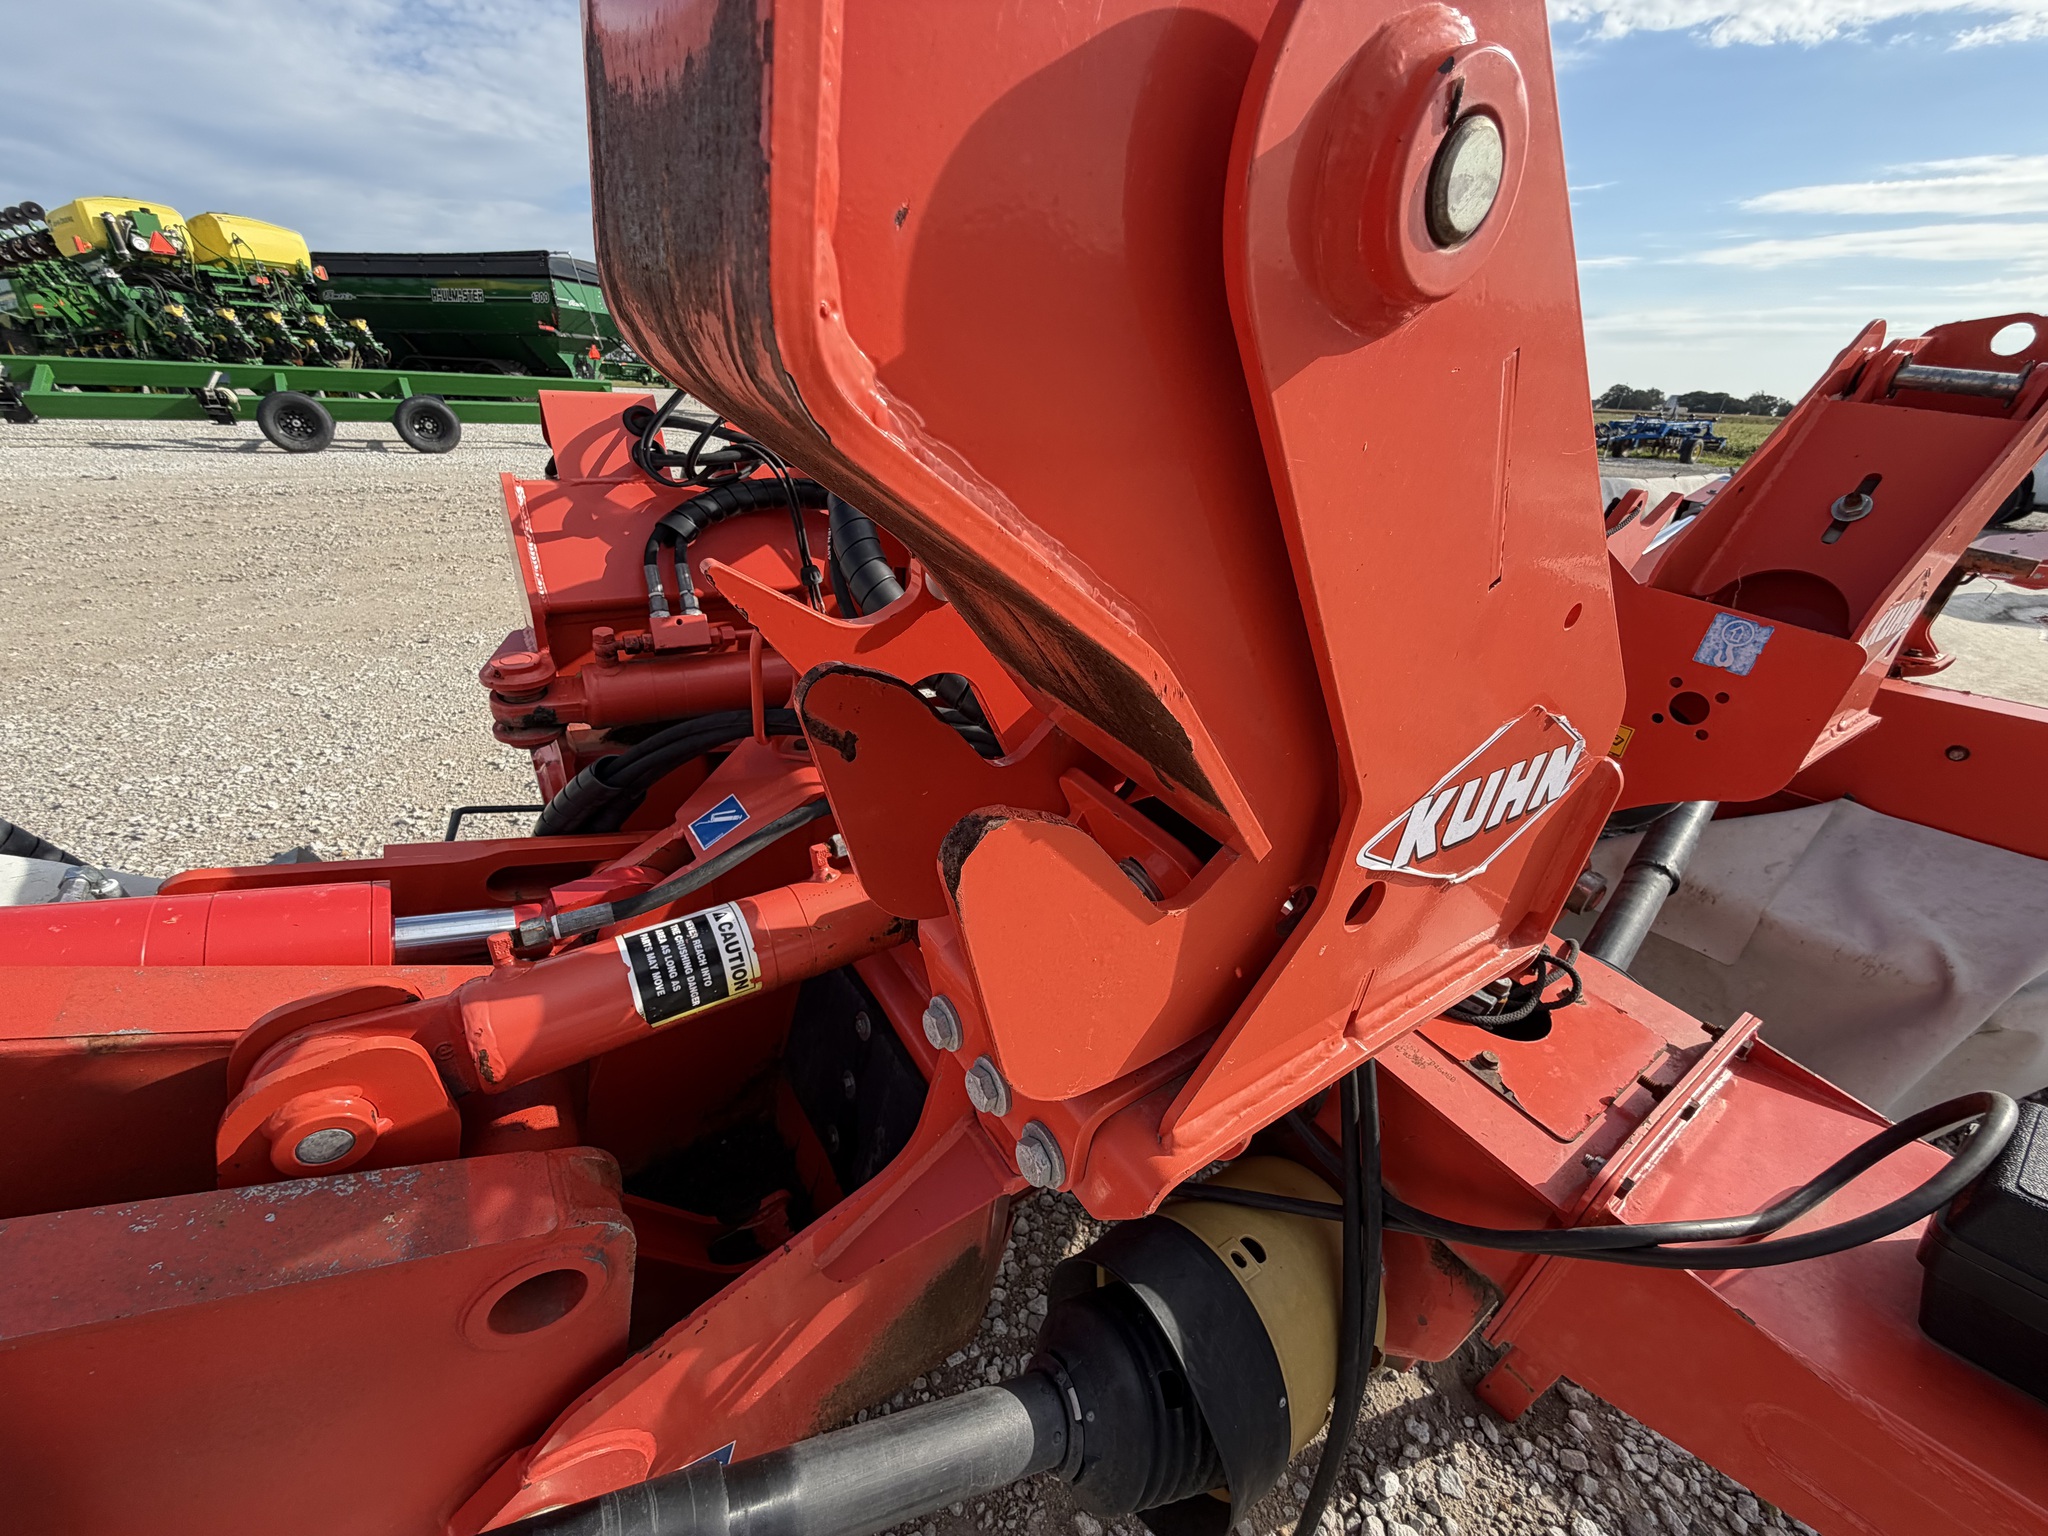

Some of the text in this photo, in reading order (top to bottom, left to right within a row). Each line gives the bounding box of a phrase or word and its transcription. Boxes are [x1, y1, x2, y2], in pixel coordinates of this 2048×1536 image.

[430, 287, 549, 304] HAULMASTER 1300
[1391, 743, 1586, 869] KUHN
[639, 933, 666, 997] PARTS MAY MOVE
[655, 929, 681, 992] AREA AS LONG AS
[670, 924, 700, 1007] THE CRUSHING DANGER
[685, 920, 712, 987] NEVER REACH INTO
[718, 922, 749, 991] CAUTION
